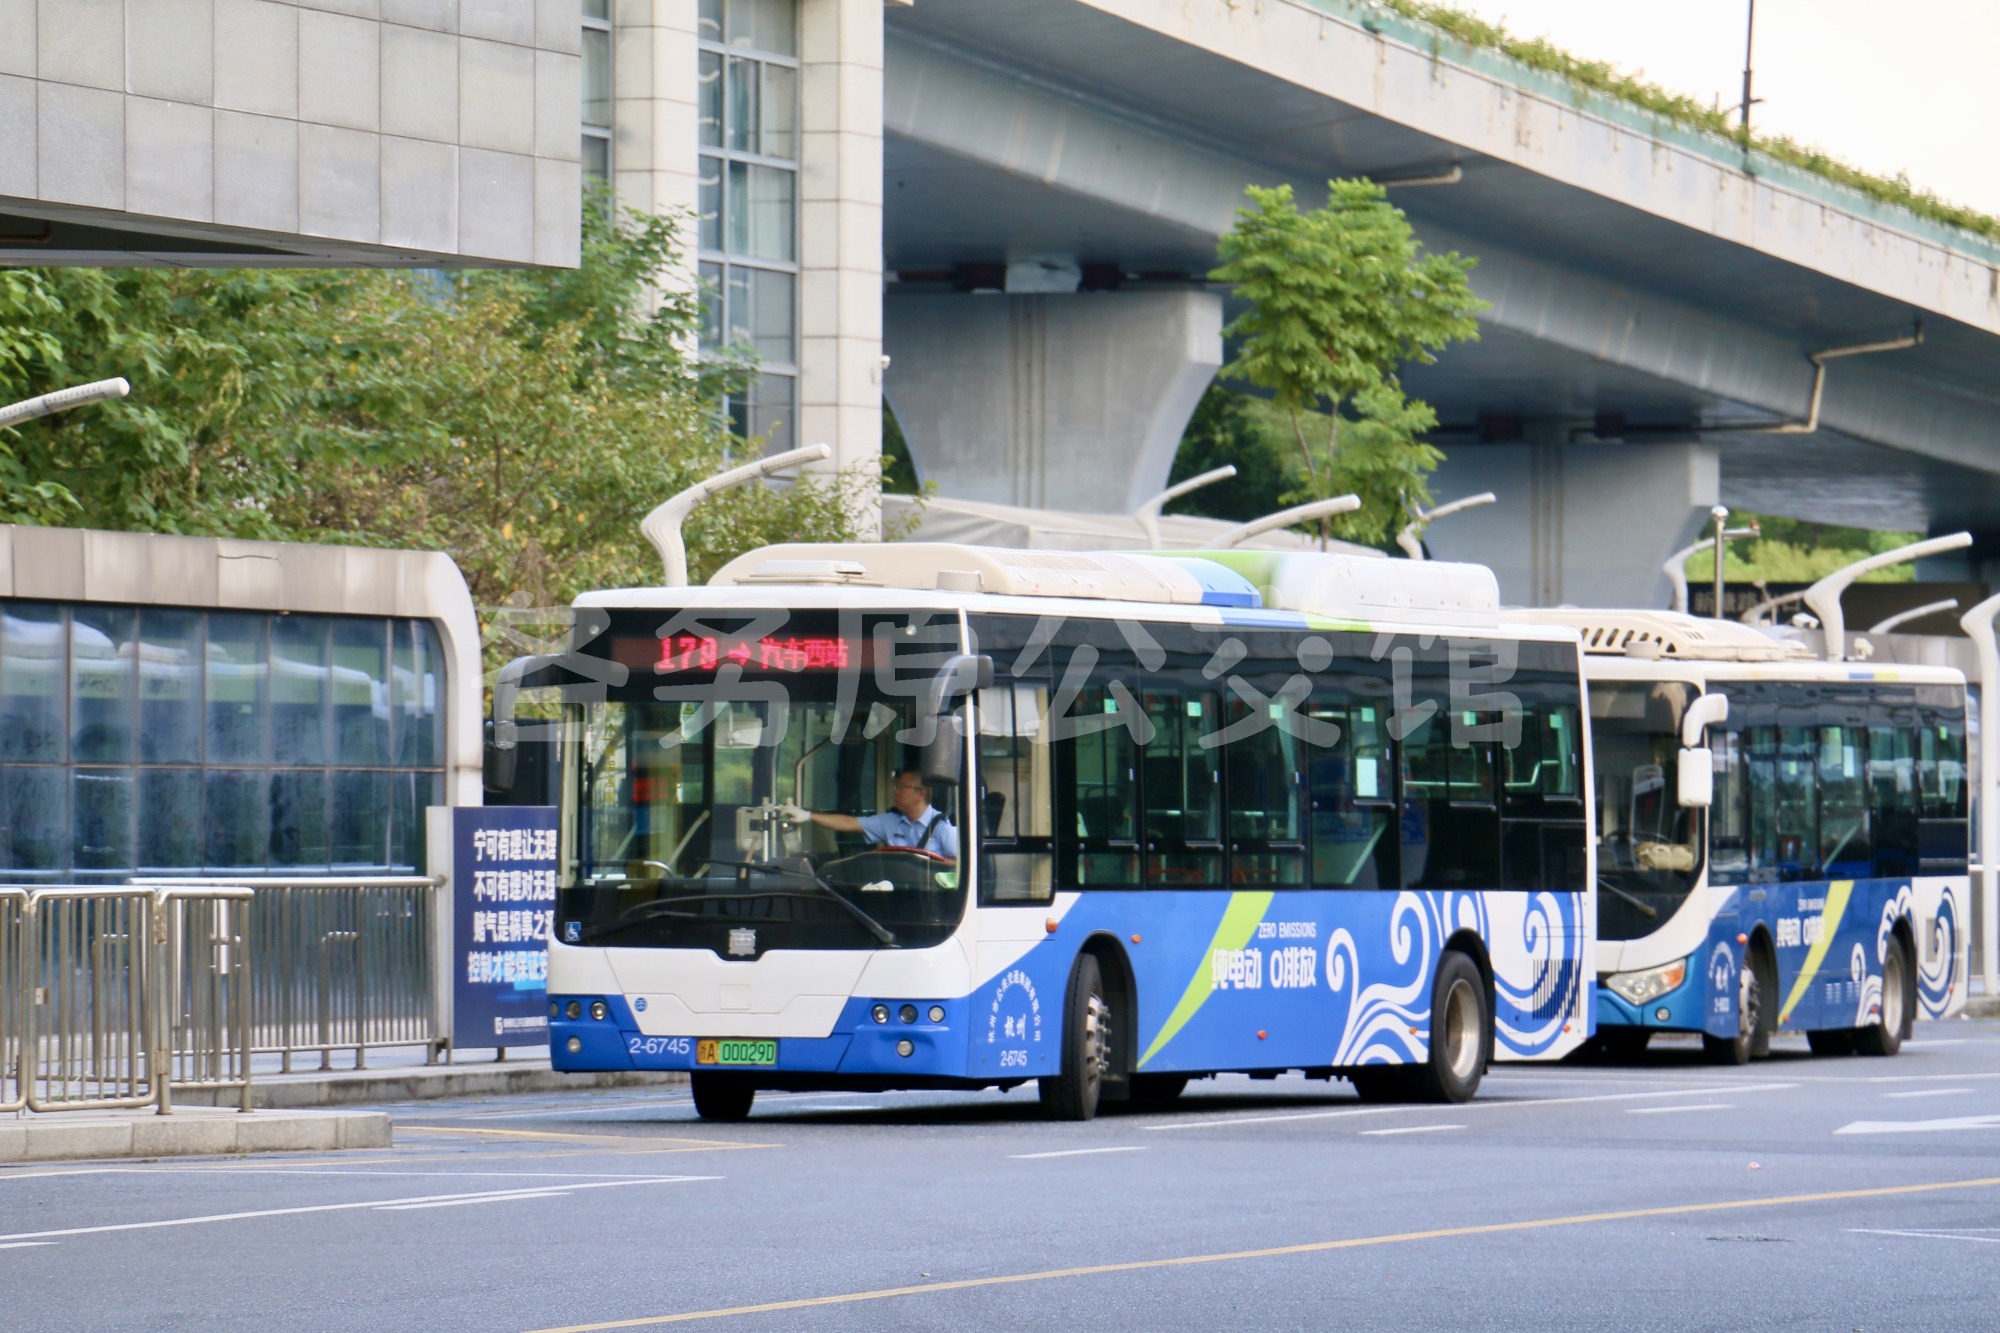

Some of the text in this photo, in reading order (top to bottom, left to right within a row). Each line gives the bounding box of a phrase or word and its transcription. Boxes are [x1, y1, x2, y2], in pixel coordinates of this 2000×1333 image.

[760, 637, 849, 669] 汽车西站
[473, 828, 557, 861] 宁可有理让无理
[473, 869, 556, 902] 不可有理对无理
[1258, 922, 1316, 938] ZERO EMISSIONS
[1211, 947, 1262, 989] 纯电动
[628, 1037, 690, 1054] 2-6745
[1000, 1049, 1028, 1067] 2-6745
